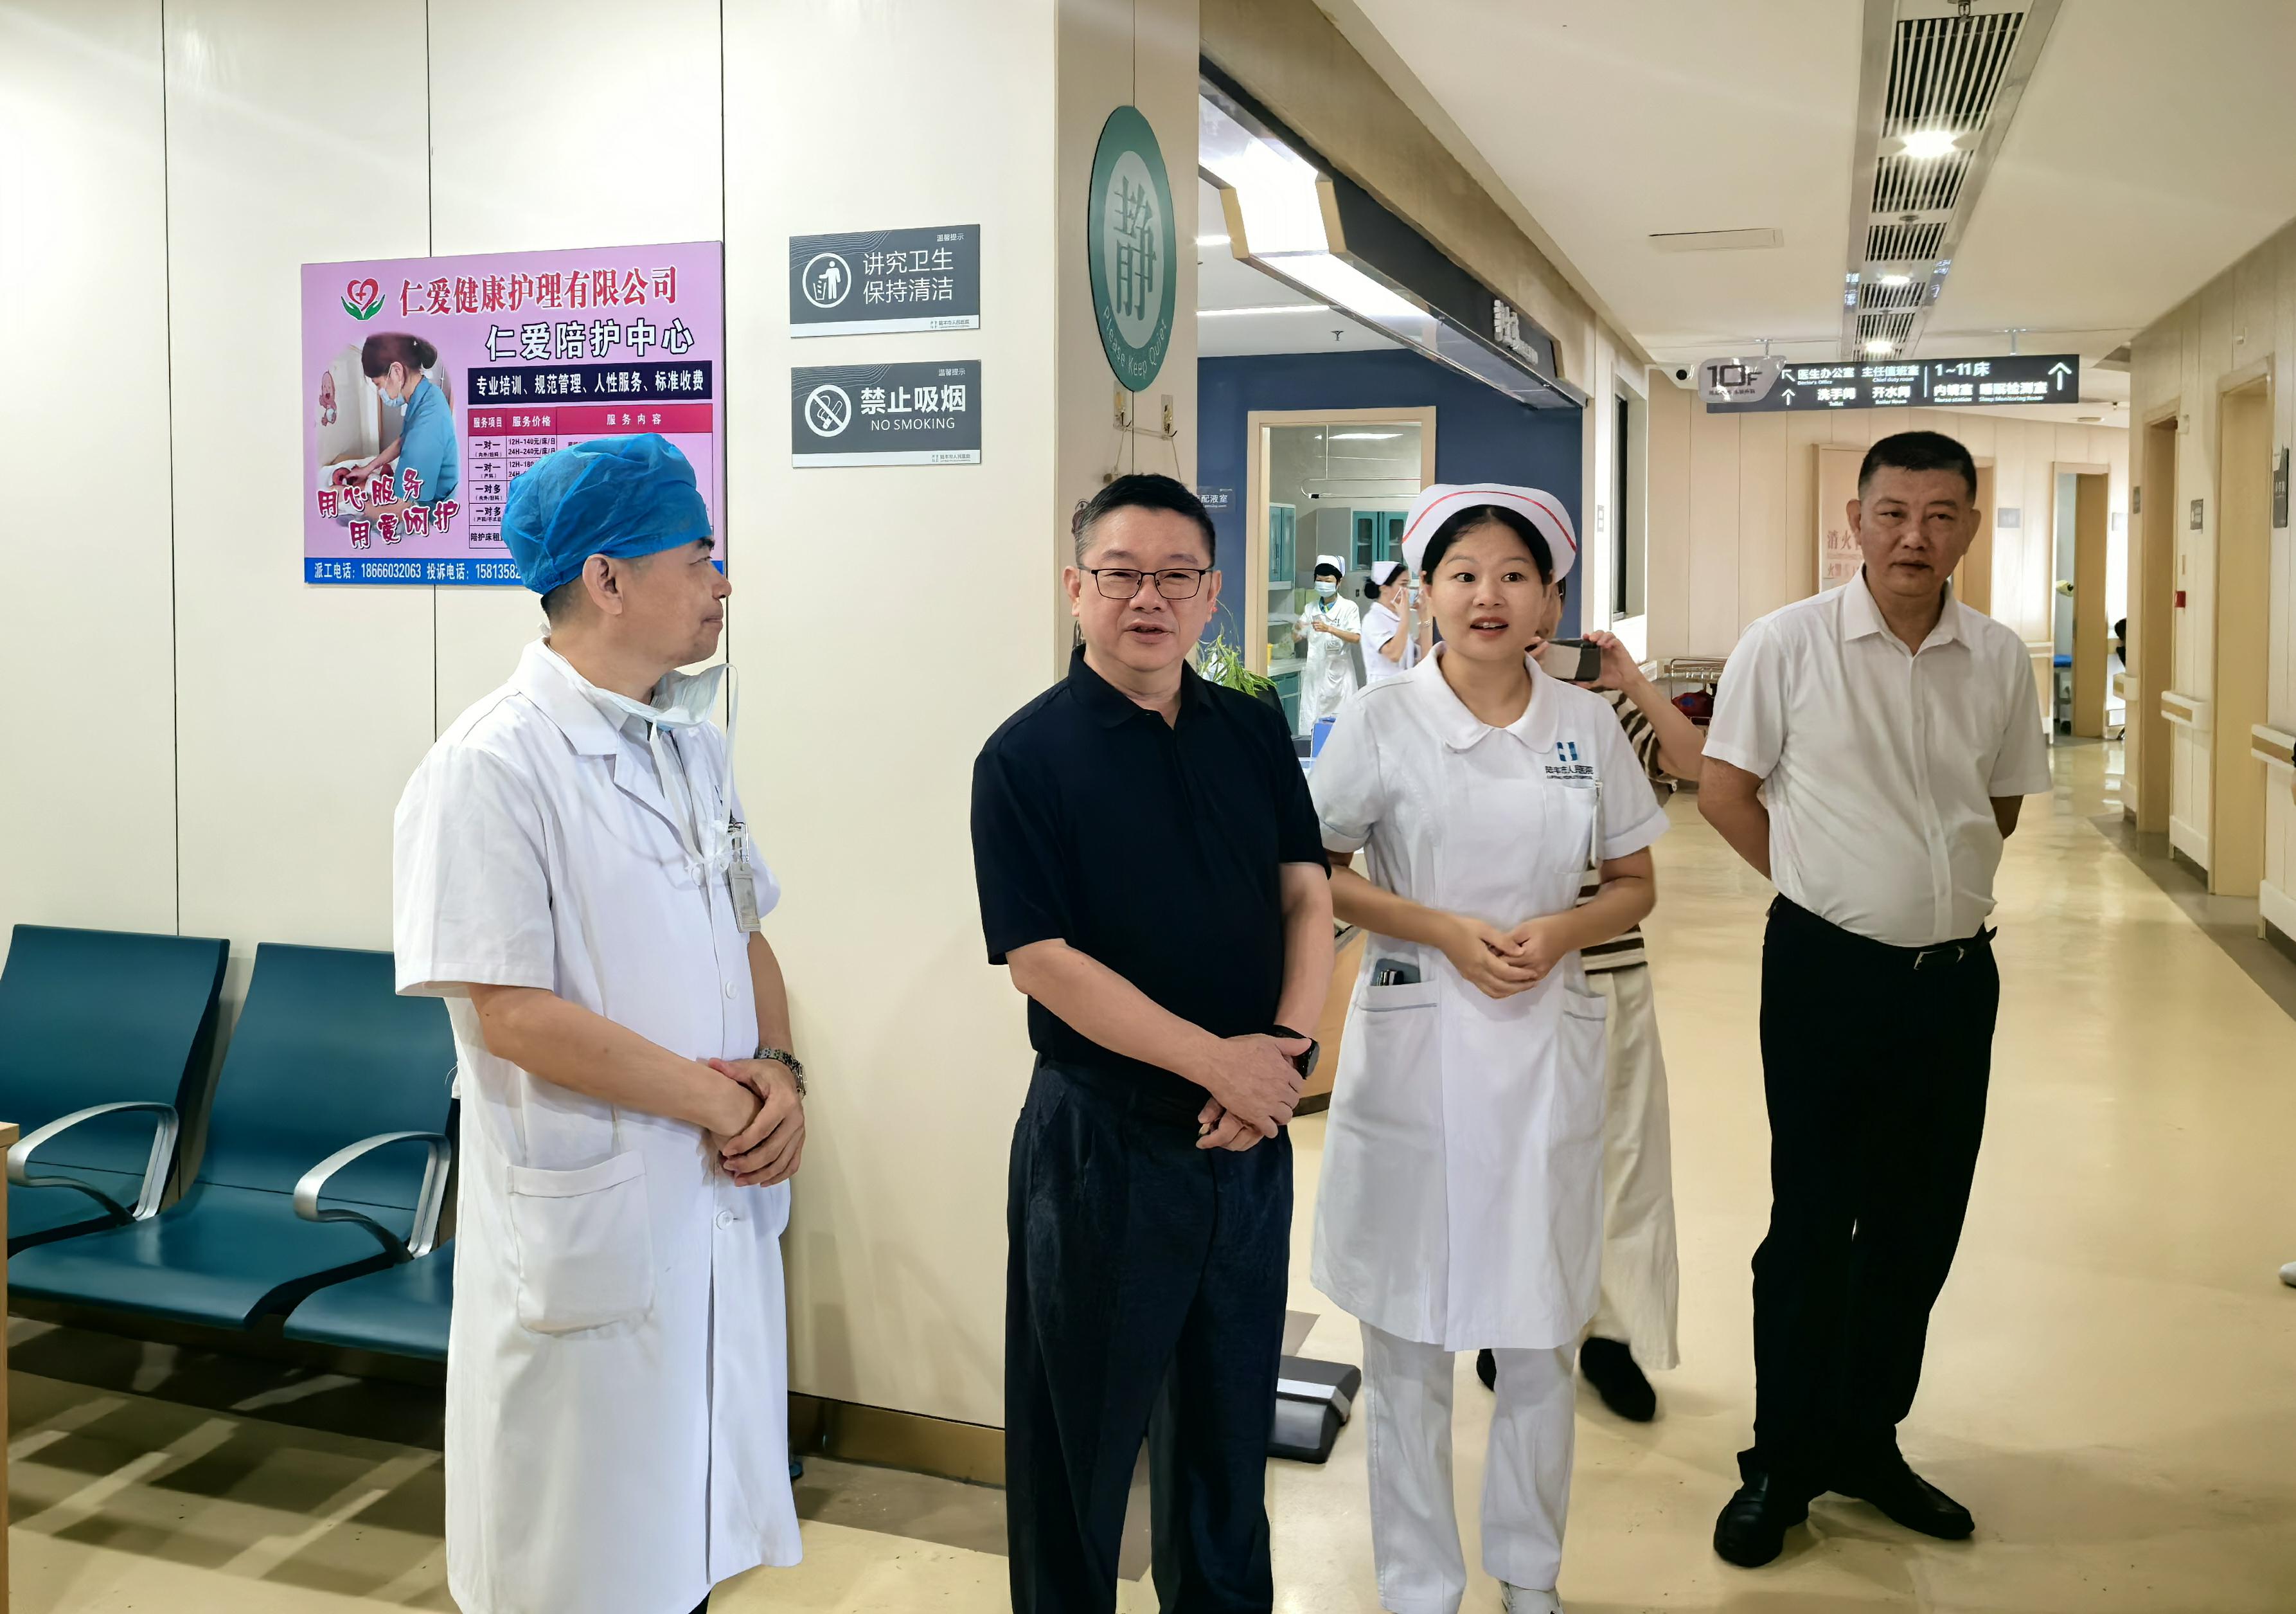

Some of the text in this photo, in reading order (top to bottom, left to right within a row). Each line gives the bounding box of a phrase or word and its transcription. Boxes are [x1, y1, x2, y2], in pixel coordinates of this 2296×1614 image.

[863, 247, 954, 276] 讲究卫生
[400, 265, 677, 318] 仁爱健康护理有限公司
[863, 276, 953, 305] 保持清洁
[485, 318, 694, 361] 仁爱陪护中心
[1103, 305, 1125, 367] Please
[1128, 355, 1147, 379] Keep
[1797, 364, 1919, 380] 医生办公室 主任值班室
[861, 384, 966, 415] 禁止吸烟
[473, 417, 503, 428] 服务项目
[512, 415, 551, 427] 服务价格
[871, 417, 955, 431] NO SMOKING
[475, 440, 501, 450] 一对一
[475, 463, 501, 472] 一对一
[317, 467, 423, 518] 用心服务
[475, 484, 501, 494] 一对多
[1197, 494, 1228, 503] 配液室
[476, 507, 501, 516] 一对多
[470, 533, 503, 541] 陪护床租
[1827, 530, 1858, 550] 消火
[360, 563, 422, 578] 18666032063
